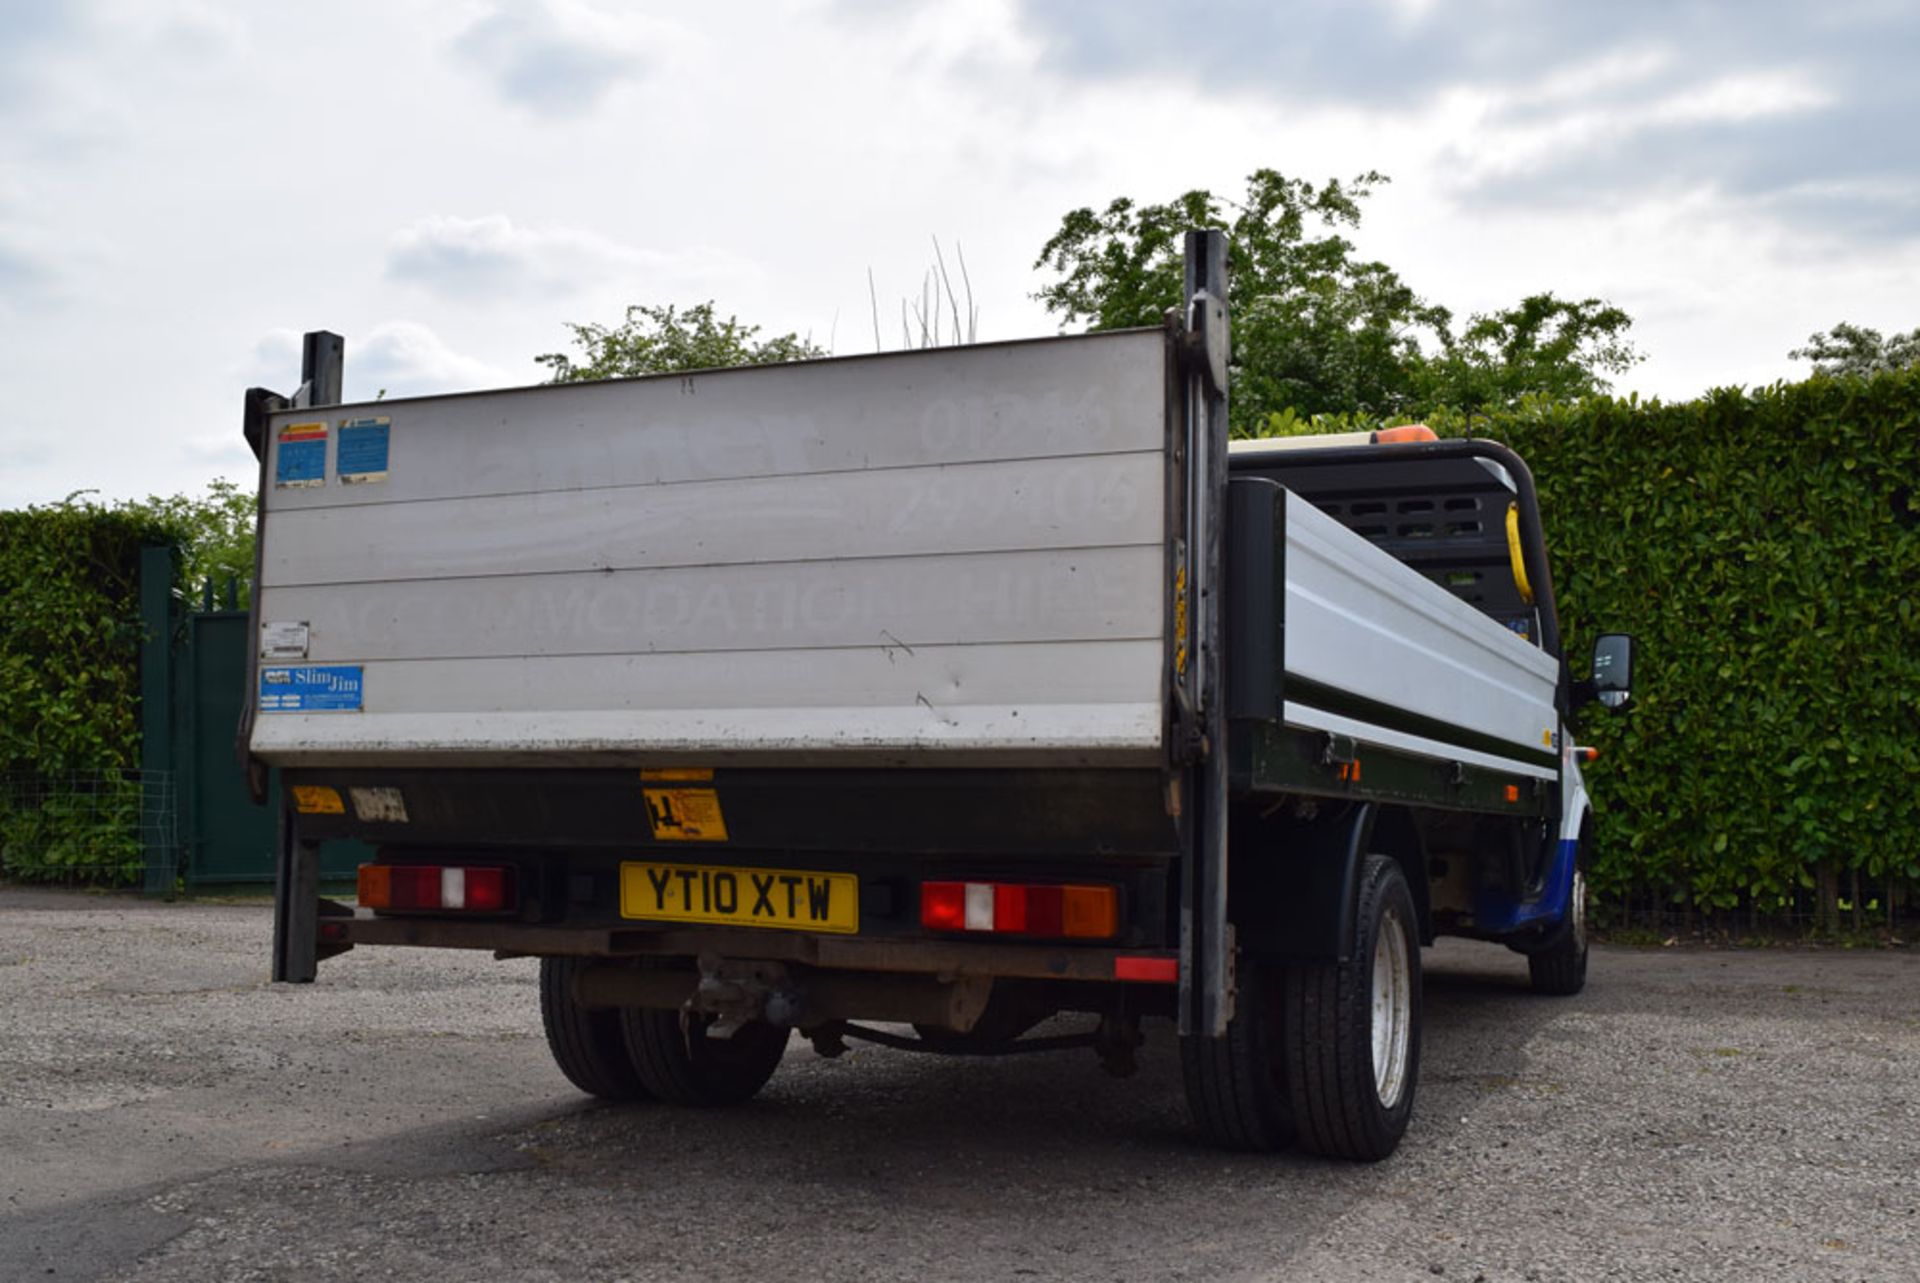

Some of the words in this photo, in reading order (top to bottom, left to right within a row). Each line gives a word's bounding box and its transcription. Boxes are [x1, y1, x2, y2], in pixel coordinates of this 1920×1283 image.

[295, 668, 331, 685] Slim
[328, 676, 358, 692] Jim
[647, 868, 738, 915] YT10
[751, 873, 831, 922] XTW
